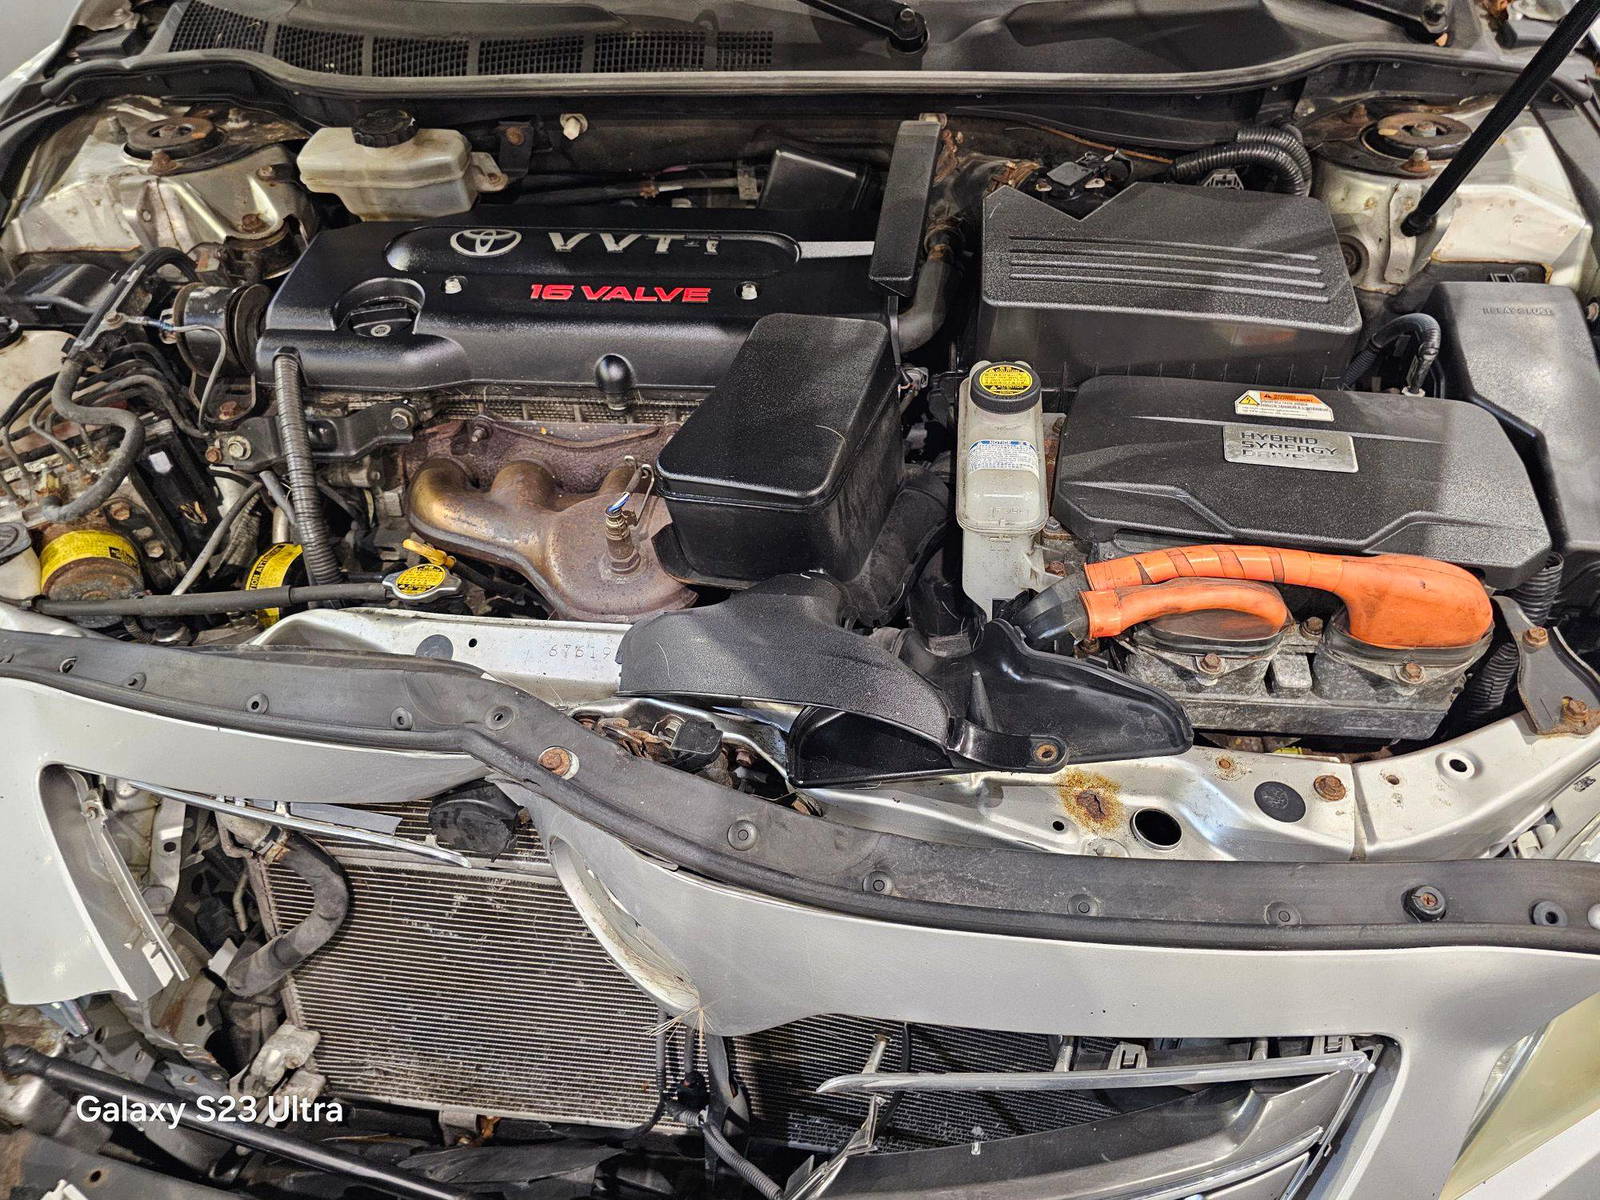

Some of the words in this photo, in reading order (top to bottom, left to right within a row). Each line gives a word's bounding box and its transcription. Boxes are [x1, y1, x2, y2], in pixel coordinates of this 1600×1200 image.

[530, 284, 574, 300] 16
[581, 285, 711, 302] VALVE
[1241, 432, 1318, 445] HYBRID
[1241, 440, 1338, 455] SYNERGY
